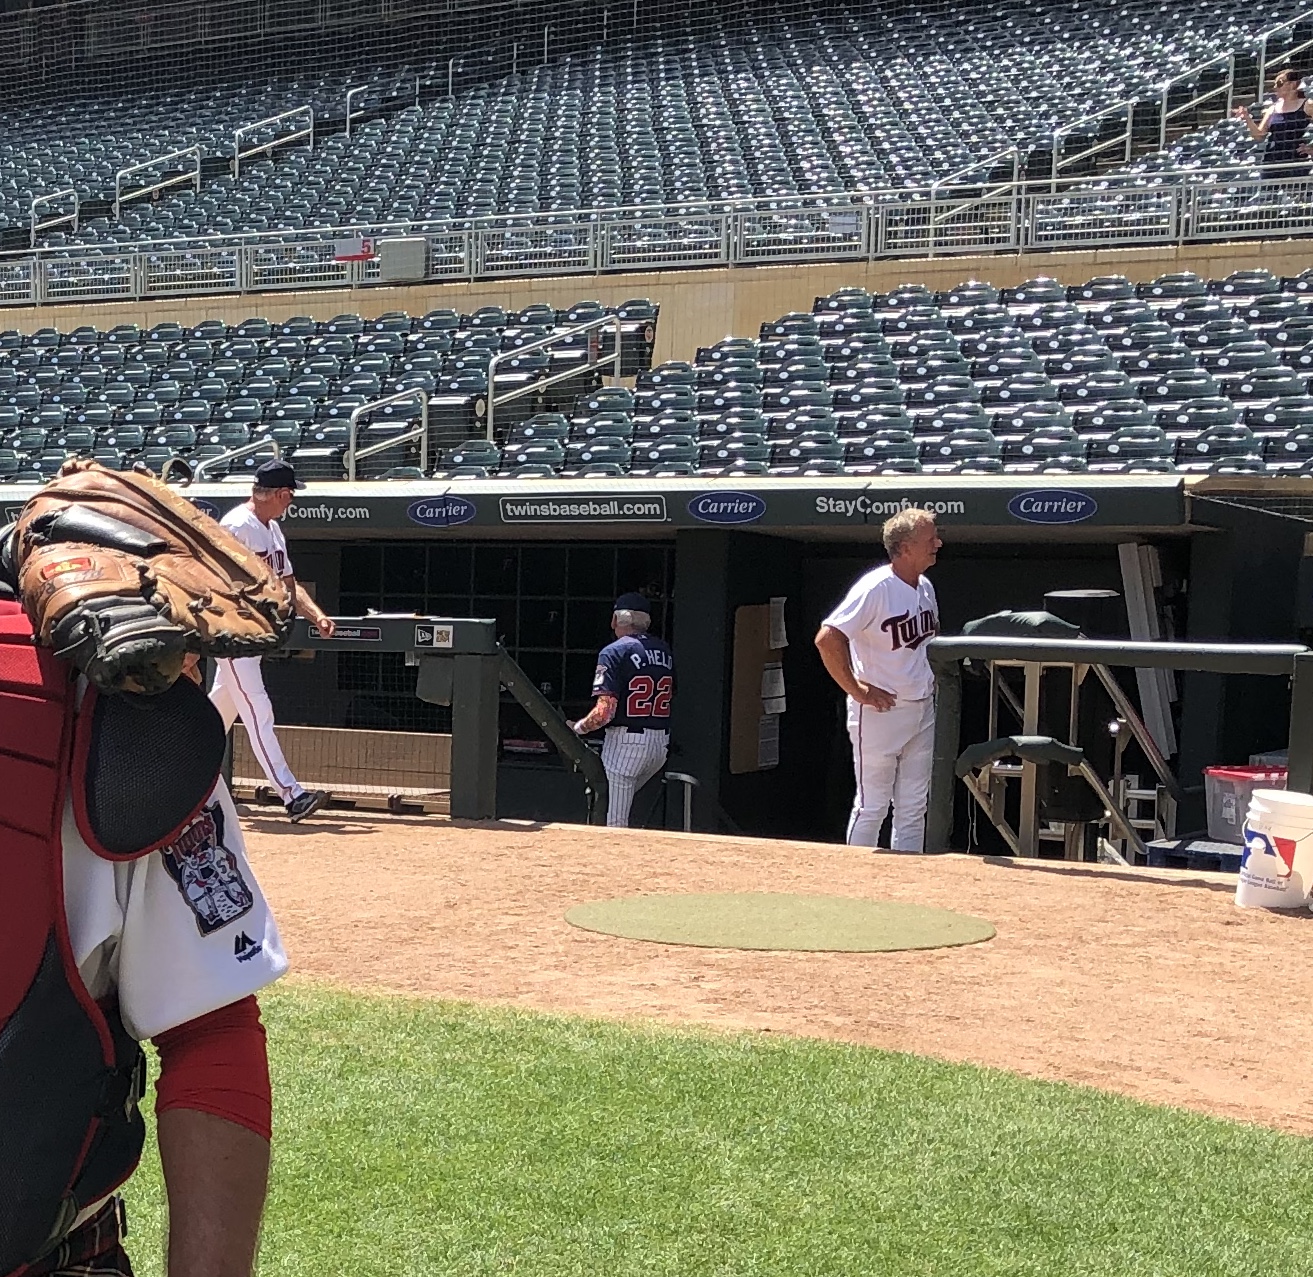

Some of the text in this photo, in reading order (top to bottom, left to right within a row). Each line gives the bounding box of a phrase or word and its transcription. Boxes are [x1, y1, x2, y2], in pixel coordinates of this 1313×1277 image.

[361, 239, 371, 255] 5
[416, 504, 468, 518] Carrier
[505, 501, 661, 516] twinsbaseball.com
[698, 498, 757, 514] Carrier
[1019, 498, 1086, 513] Carrier
[626, 675, 673, 718] 22
